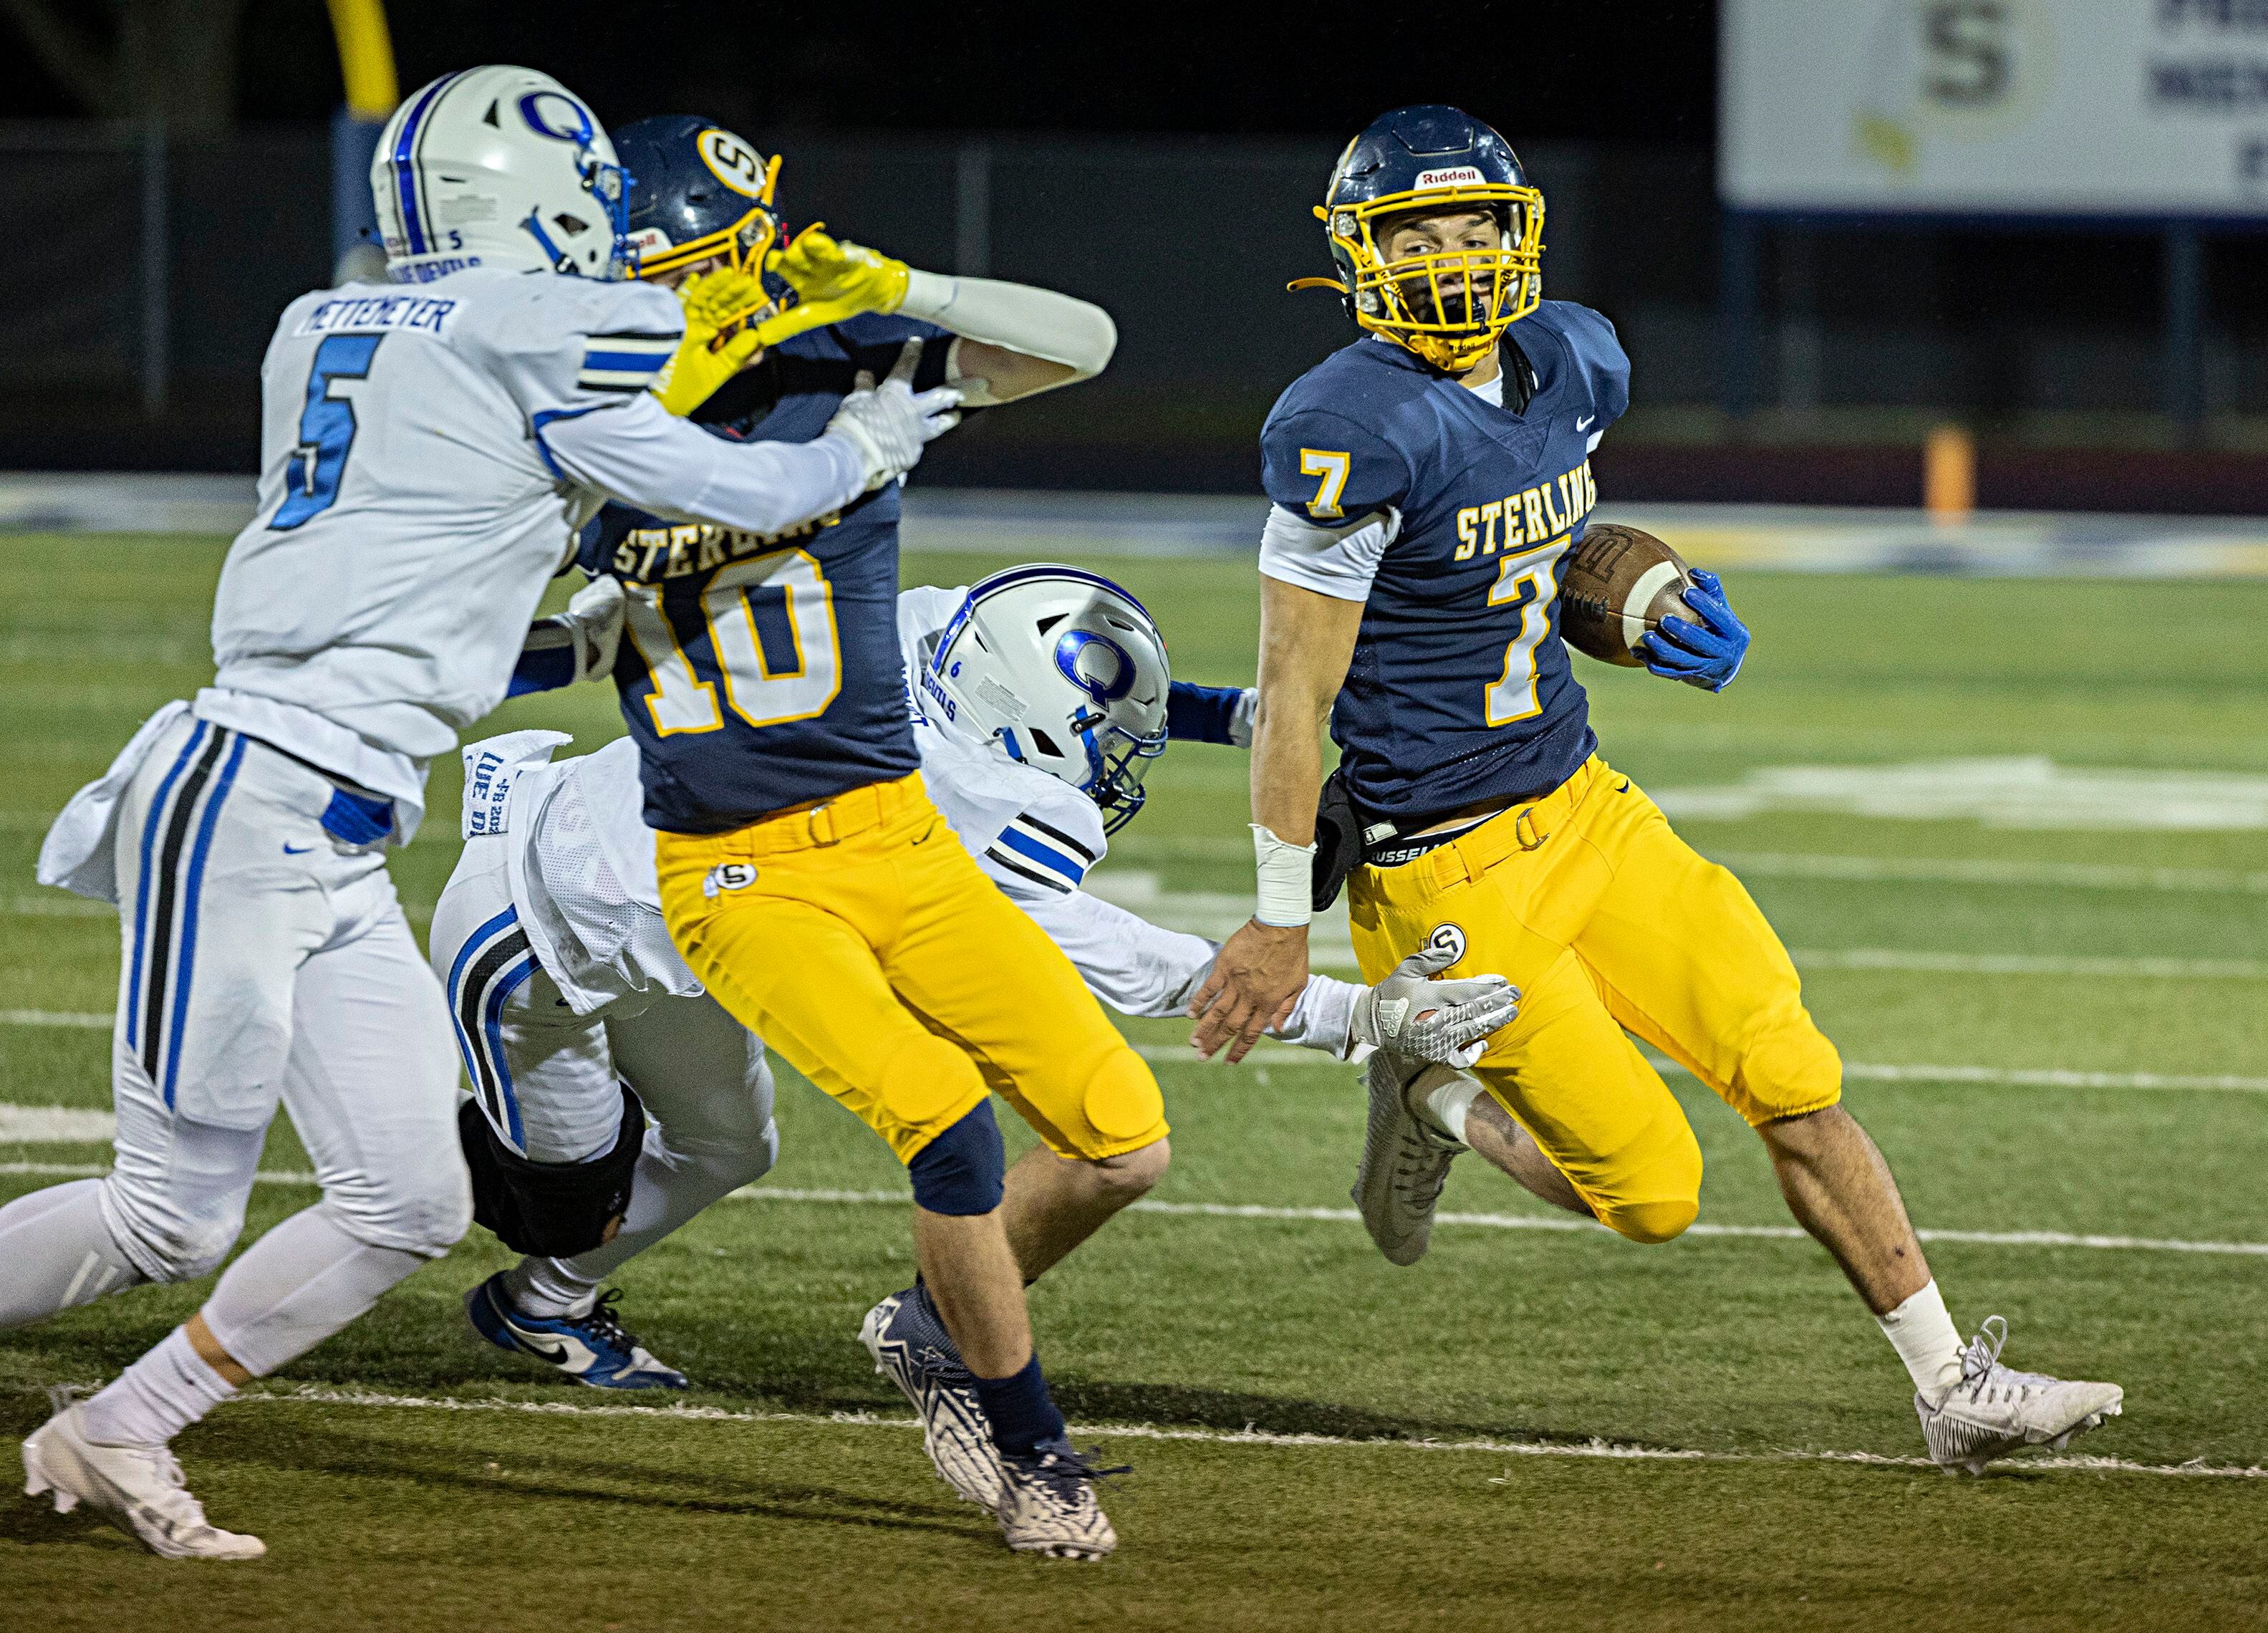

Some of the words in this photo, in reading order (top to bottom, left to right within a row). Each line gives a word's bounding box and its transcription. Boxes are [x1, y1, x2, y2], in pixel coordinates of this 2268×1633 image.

[518, 90, 596, 155] Q
[714, 137, 756, 183] S
[1422, 170, 1476, 184] Riddell
[266, 331, 388, 531] 5
[1300, 448, 1351, 519] 7
[1454, 459, 1597, 562] STERLING
[624, 546, 843, 738] 10
[1485, 533, 1571, 728] 7
[950, 661, 962, 678] 6
[1053, 629, 1137, 713] Q
[723, 864, 746, 884] S
[1371, 844, 1440, 862] USSEL
